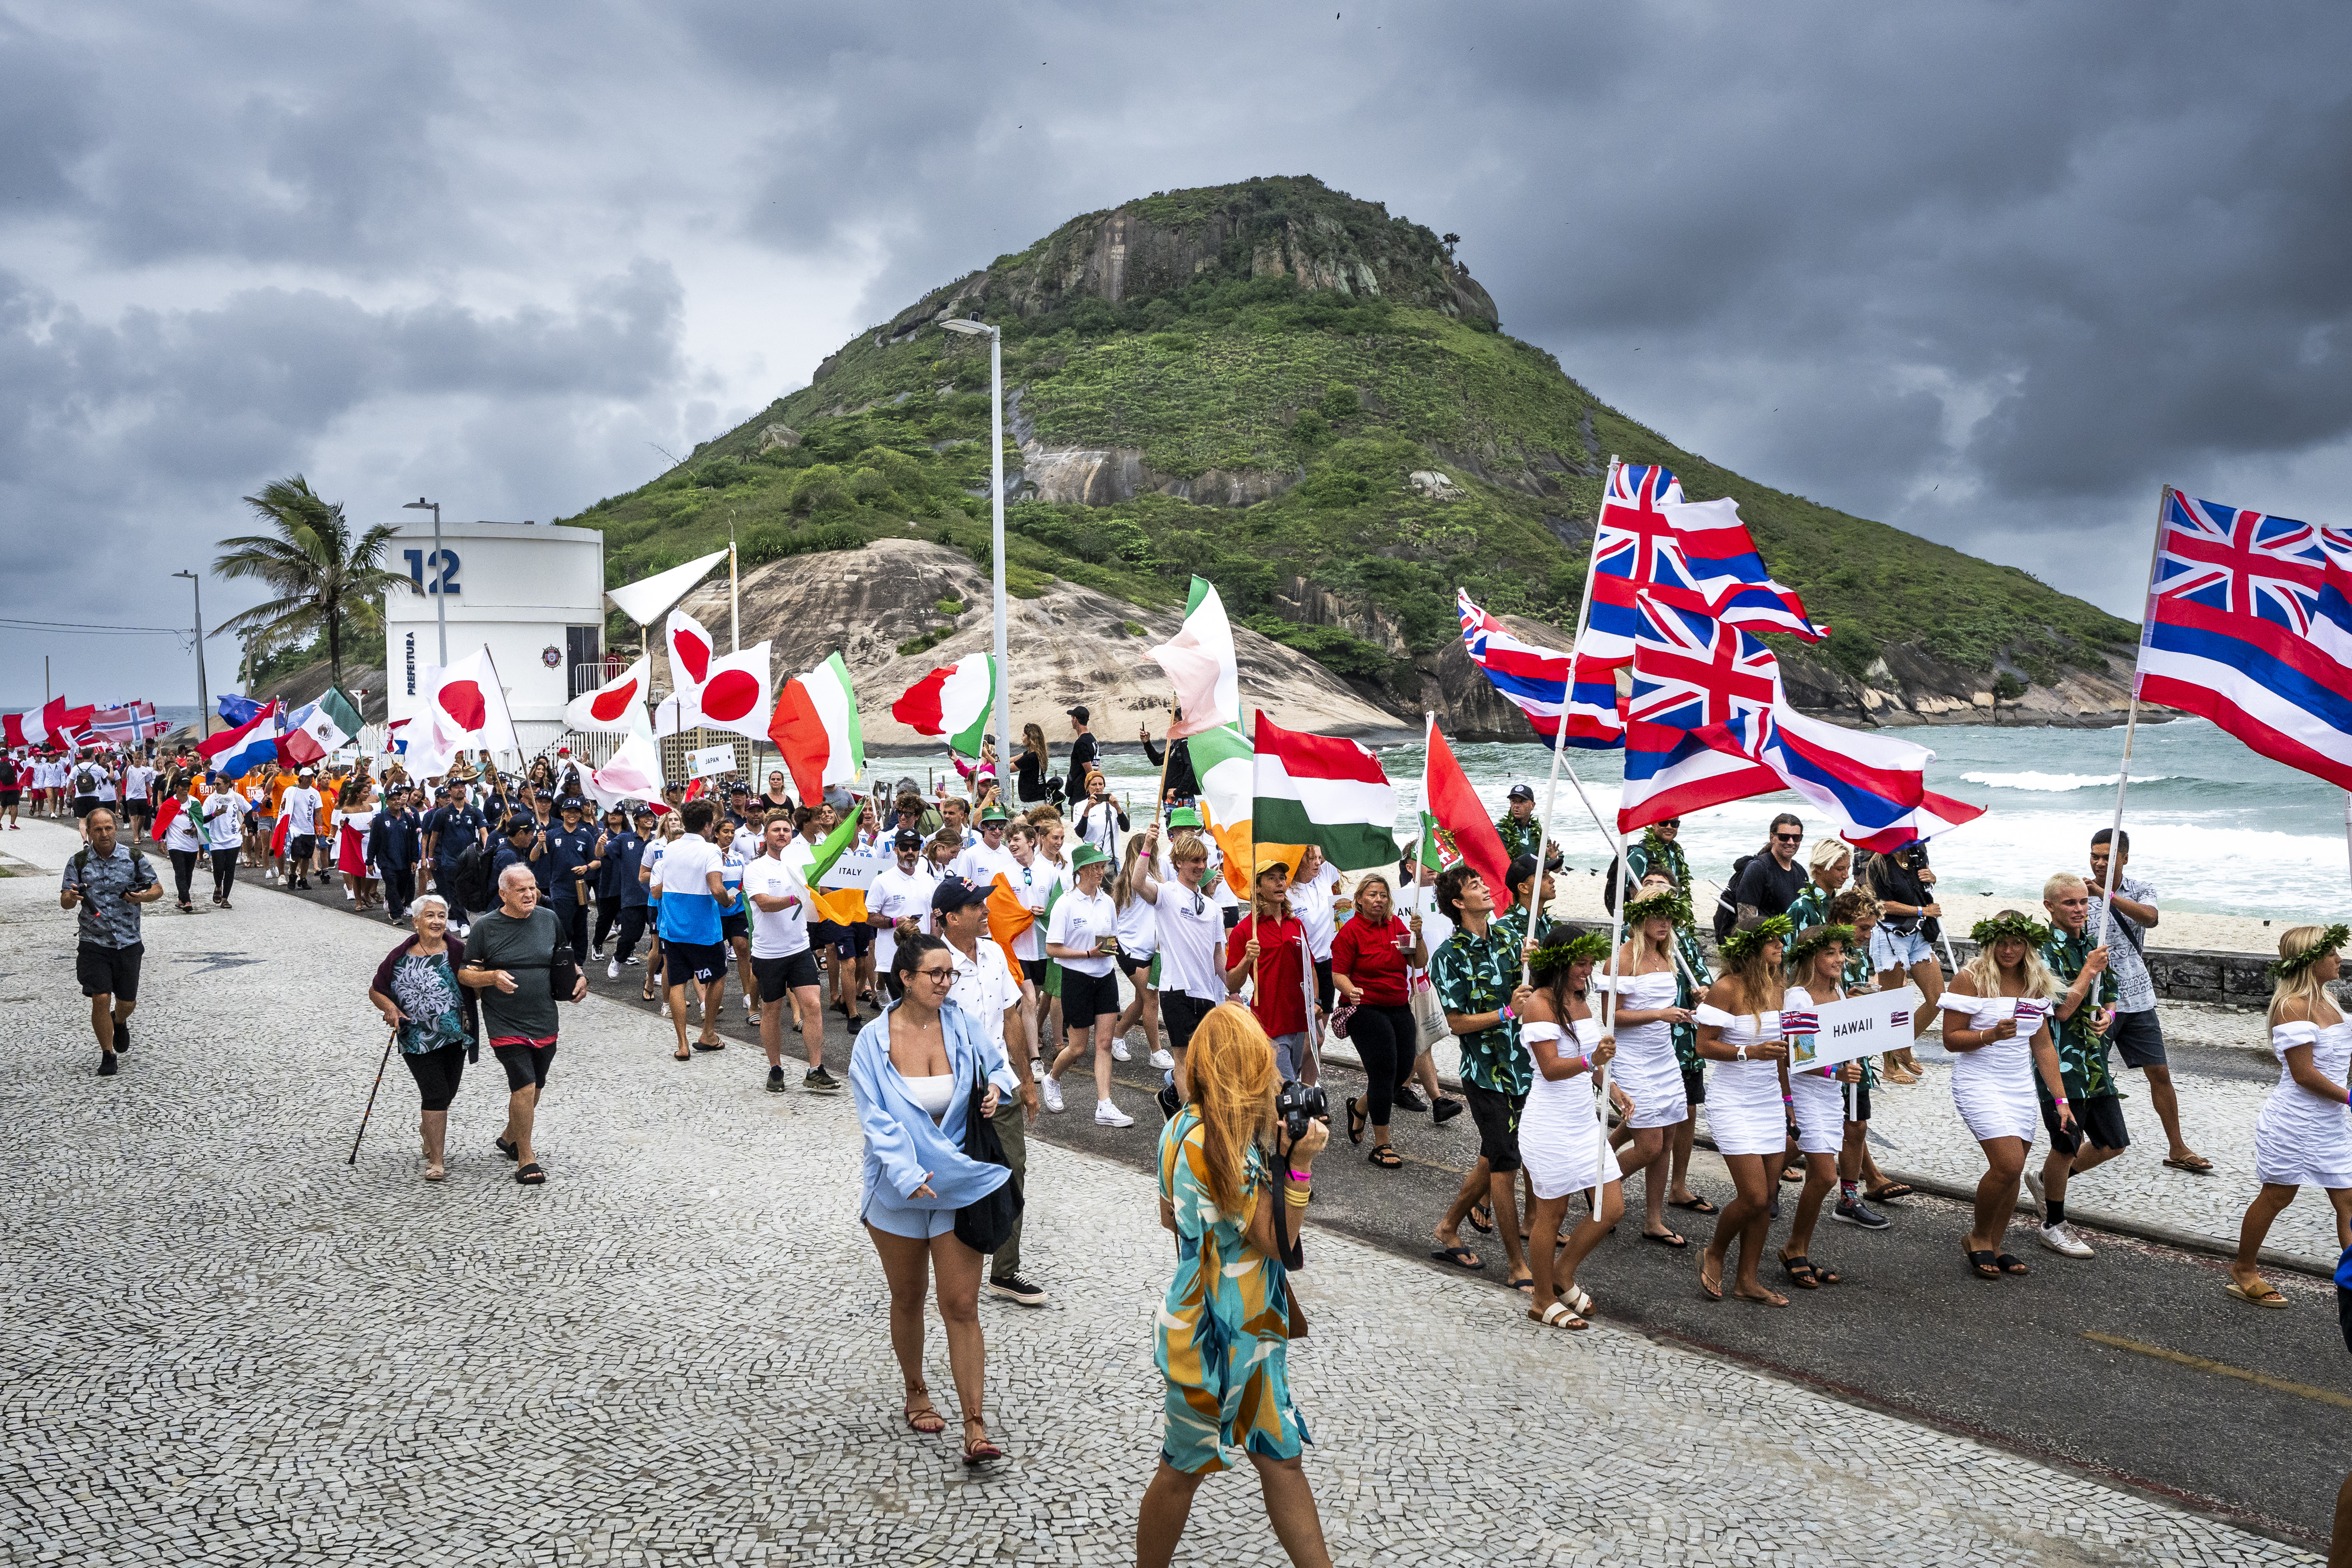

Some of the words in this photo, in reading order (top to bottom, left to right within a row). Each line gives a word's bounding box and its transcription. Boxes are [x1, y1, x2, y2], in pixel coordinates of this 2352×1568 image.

[403, 549, 460, 593] 12
[406, 631, 415, 695] PREFEITURA
[705, 756, 719, 764] JAPAN
[838, 867, 862, 876] ITALY
[1833, 1017, 1873, 1038] HAWAII
